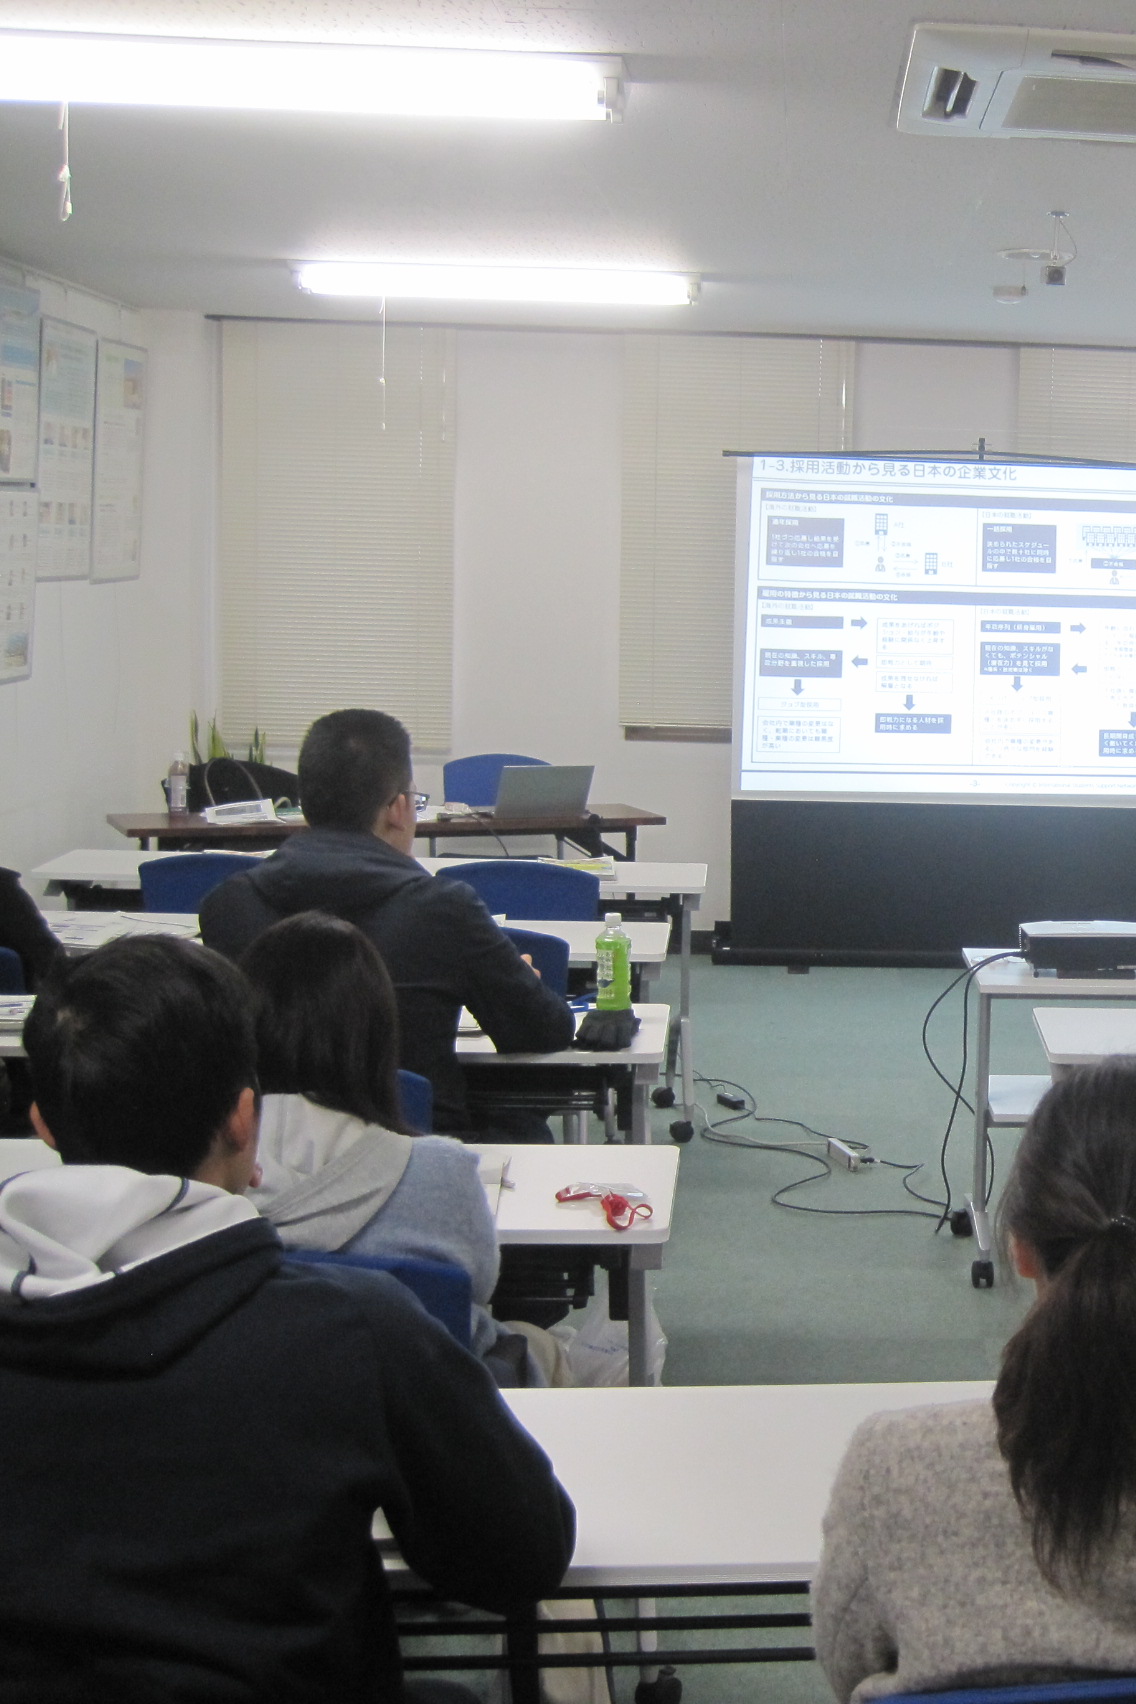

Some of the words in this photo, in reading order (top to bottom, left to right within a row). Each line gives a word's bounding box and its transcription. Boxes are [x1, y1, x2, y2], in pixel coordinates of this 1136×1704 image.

[760, 459, 1018, 481] 1-3.採用活動から見る日本の企業文化
